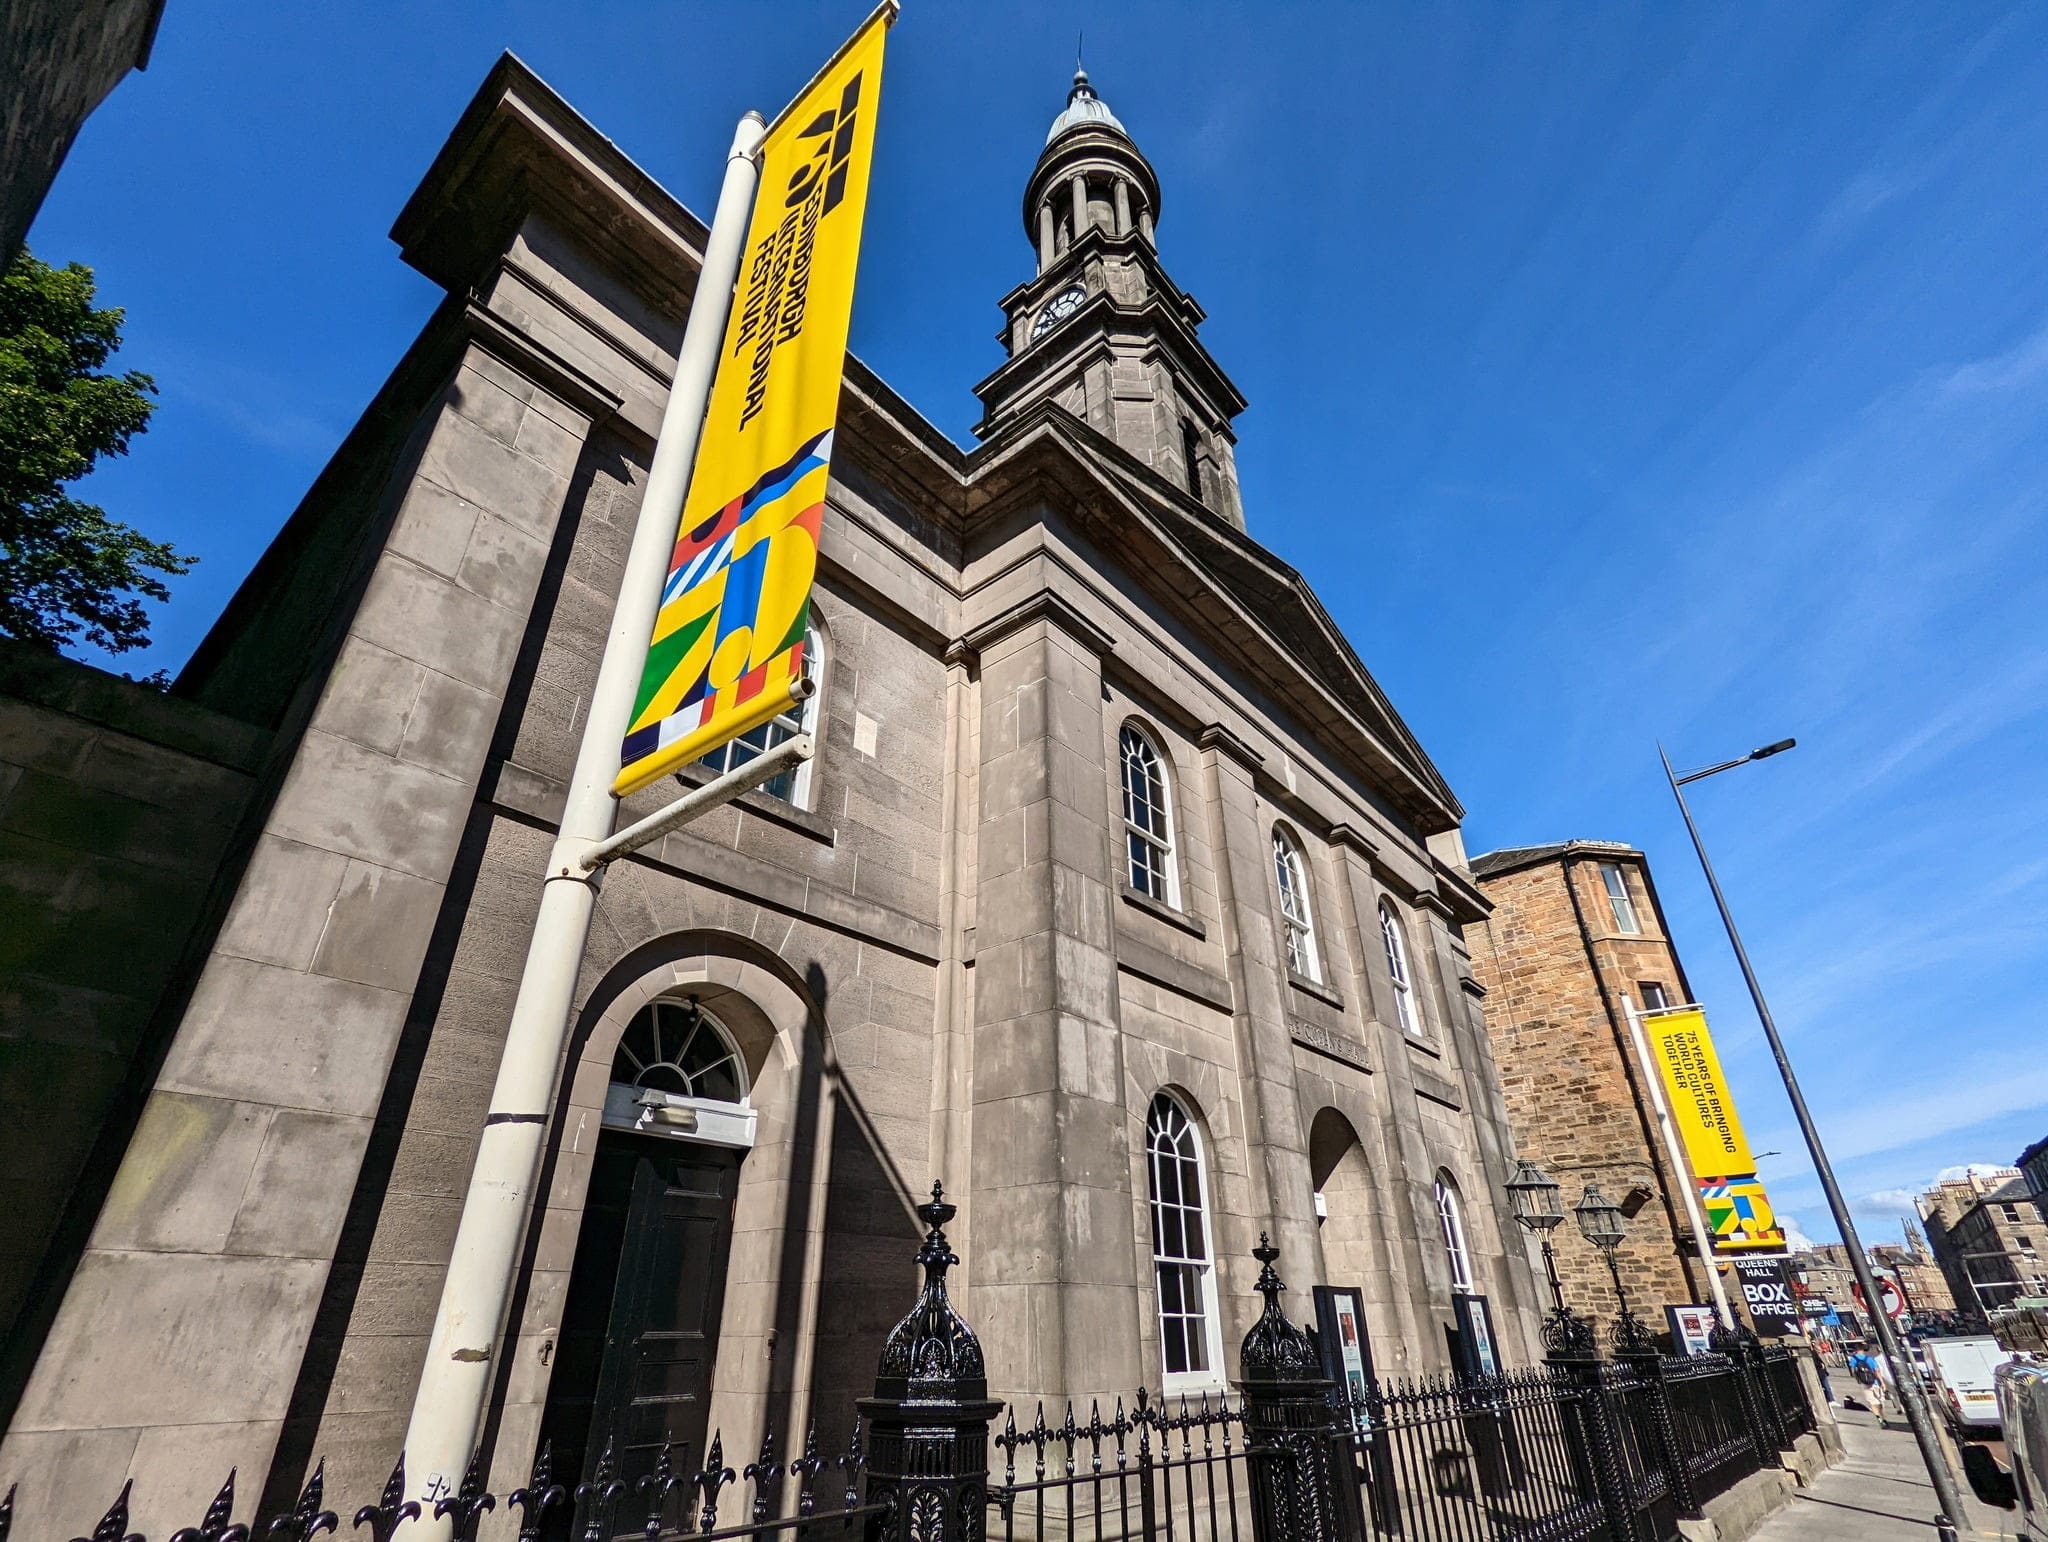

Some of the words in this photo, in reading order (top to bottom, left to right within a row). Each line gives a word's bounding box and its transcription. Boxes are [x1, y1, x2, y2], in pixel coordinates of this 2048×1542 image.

[776, 186, 824, 346] EDINBURGH
[735, 231, 777, 358] FESTIVAL
[738, 207, 801, 432] INTERNATIONAL
[1685, 1030, 1699, 1043] 75
[1662, 1034, 1687, 1089] TOGETHER
[1690, 1044, 1711, 1080] YEARS
[1674, 1032, 1694, 1071] WORLD
[1688, 1072, 1714, 1129] CULTURES
[1703, 1082, 1717, 1096] OF
[1708, 1098, 1737, 1154] BRINGING
[1736, 1259, 1777, 1268] QUEENS
[1746, 1269, 1773, 1277] HALL
[1742, 1283, 1791, 1302] BOX
[1750, 1304, 1795, 1315] OFFICE
